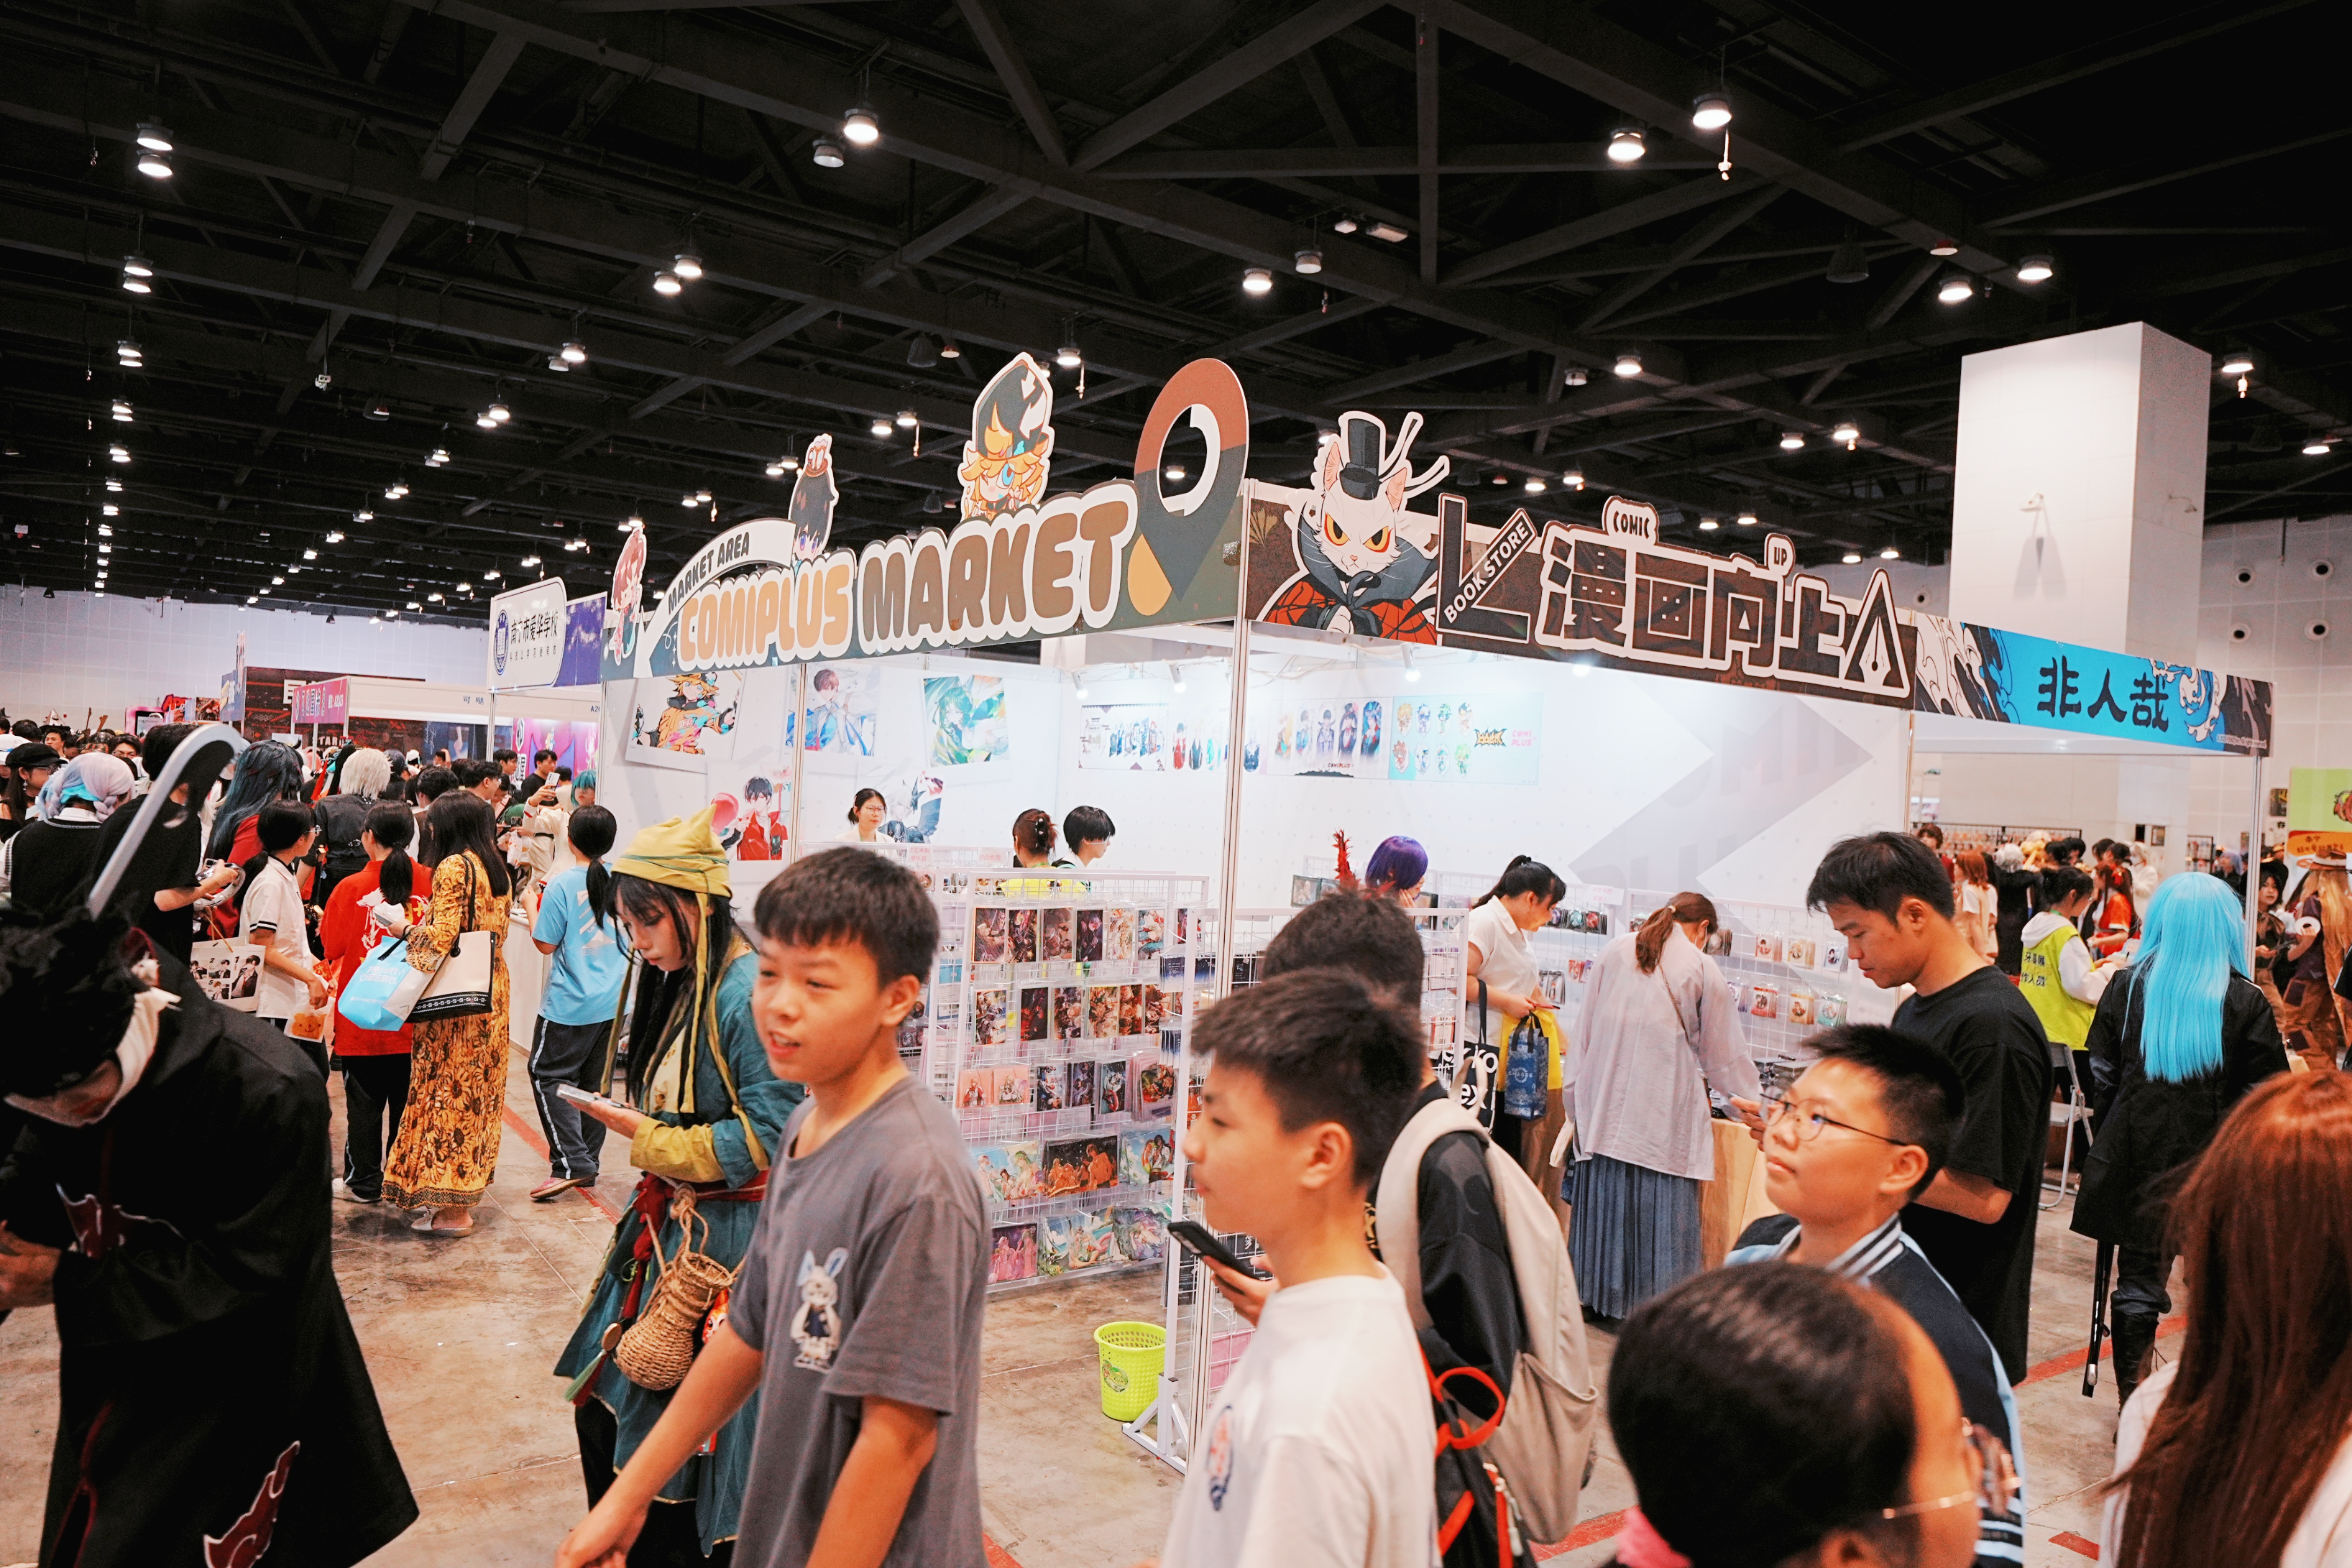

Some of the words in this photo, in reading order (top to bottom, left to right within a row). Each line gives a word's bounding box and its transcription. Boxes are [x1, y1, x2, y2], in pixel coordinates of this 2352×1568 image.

[1613, 503, 1650, 540] COMIC
[1774, 547, 1787, 565] UP
[668, 560, 714, 615] MARKET
[718, 532, 750, 567] AREA
[680, 564, 850, 662] COMIPLUS
[863, 501, 1129, 642] MARKET
[1444, 571, 1487, 624] BOOK
[1484, 521, 1529, 578] STORE
[1543, 535, 1841, 678] 漫画向上
[511, 609, 558, 644] 南宁市爱华学校
[2037, 656, 2169, 732] 非人哉
